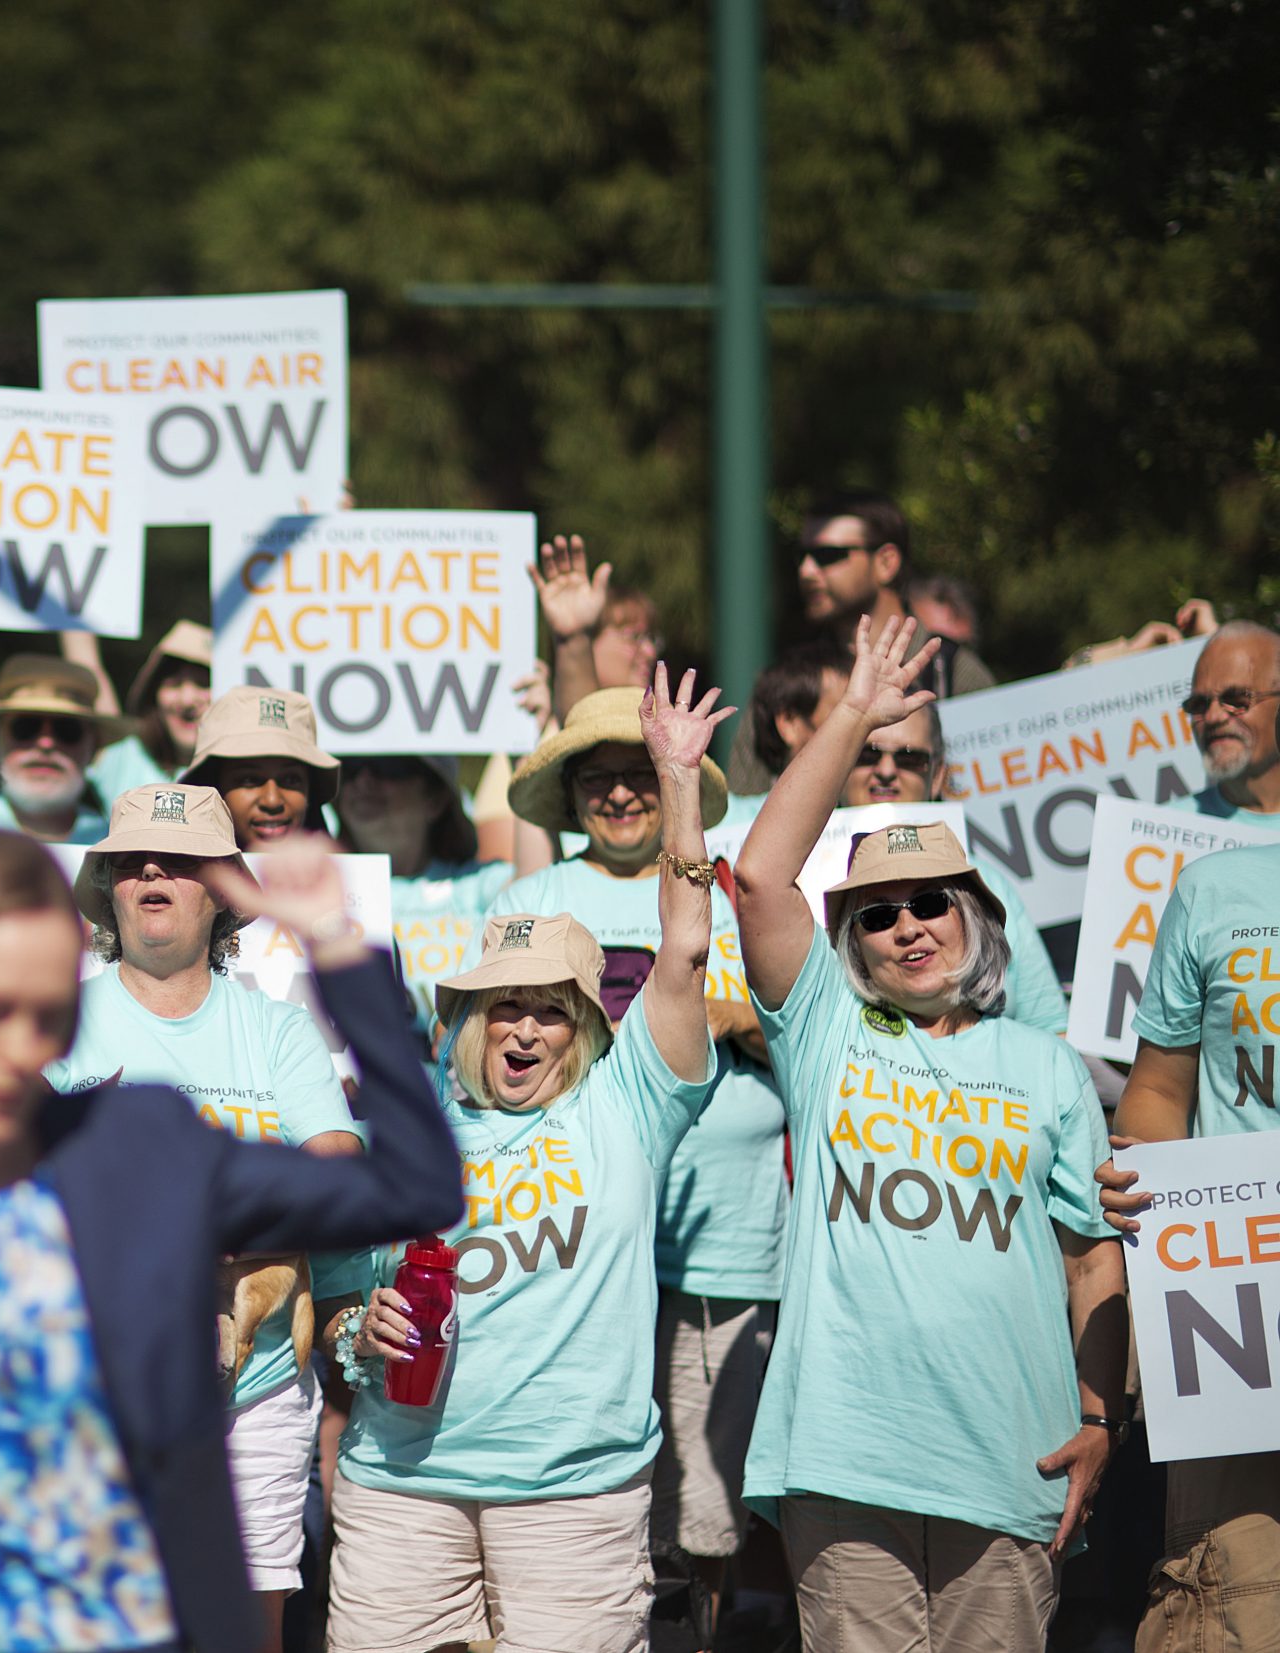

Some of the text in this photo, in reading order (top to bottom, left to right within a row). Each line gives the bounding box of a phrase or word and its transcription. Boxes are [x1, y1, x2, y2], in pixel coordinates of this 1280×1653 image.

[64, 352, 326, 396] CLEAN AIR
[147, 399, 328, 478] OW
[240, 550, 501, 597] CLIMATE
[241, 603, 502, 655] ACTION
[941, 728, 1107, 801] CLEAN
[1131, 818, 1218, 850] PROTECT
[839, 1063, 1030, 1133] CLIMATE
[899, 1064, 931, 1080] OUR
[828, 1109, 1029, 1185] ACTION
[828, 1161, 1024, 1253] NOW
[1152, 1182, 1266, 1210] PROTECT
[451, 1205, 589, 1295] OW
